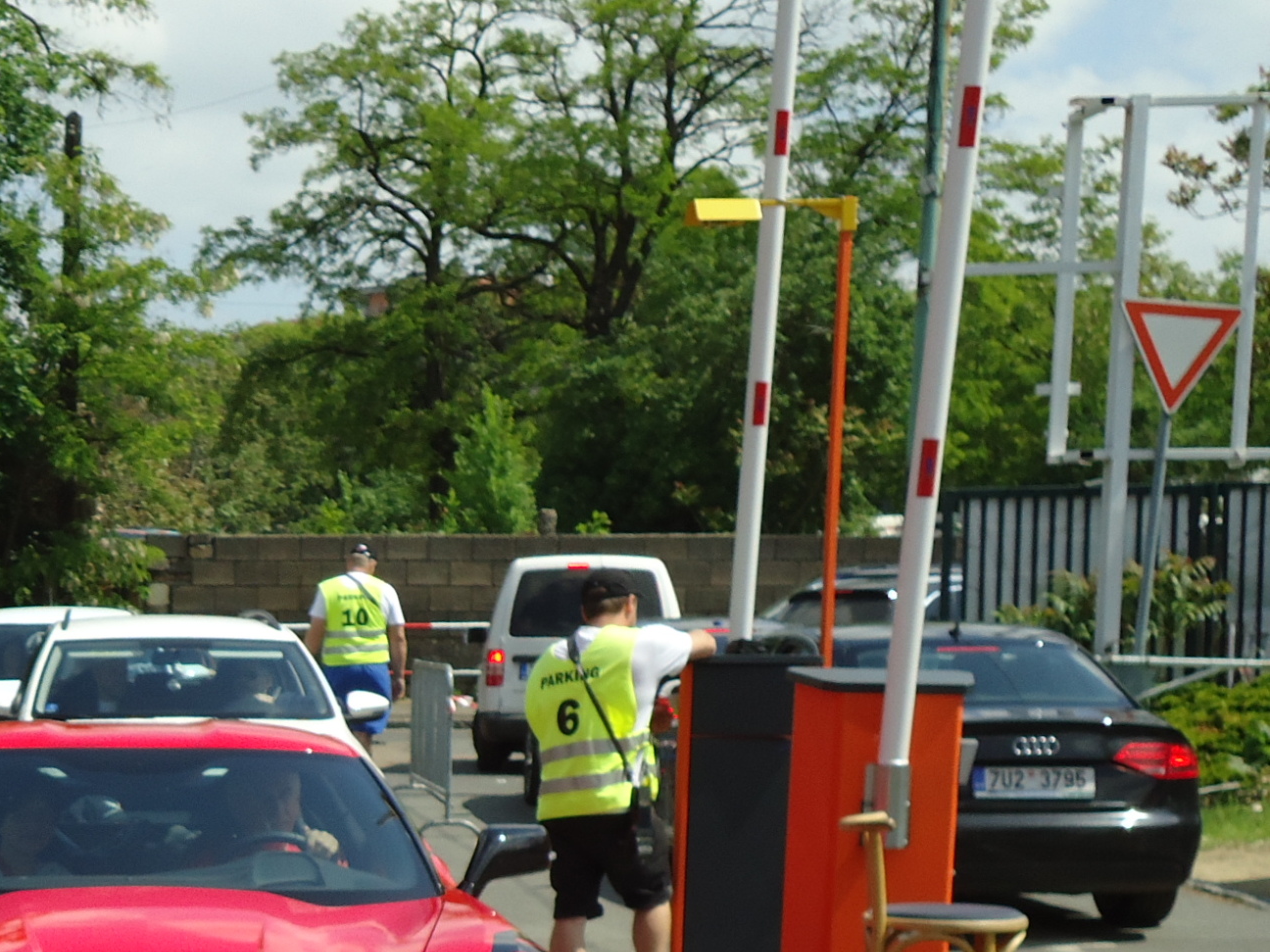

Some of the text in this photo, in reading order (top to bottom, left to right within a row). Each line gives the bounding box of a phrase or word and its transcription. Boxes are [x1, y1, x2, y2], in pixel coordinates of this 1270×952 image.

[342, 608, 369, 626] 10
[557, 699, 580, 736] 6
[990, 769, 1025, 791] 7U2
